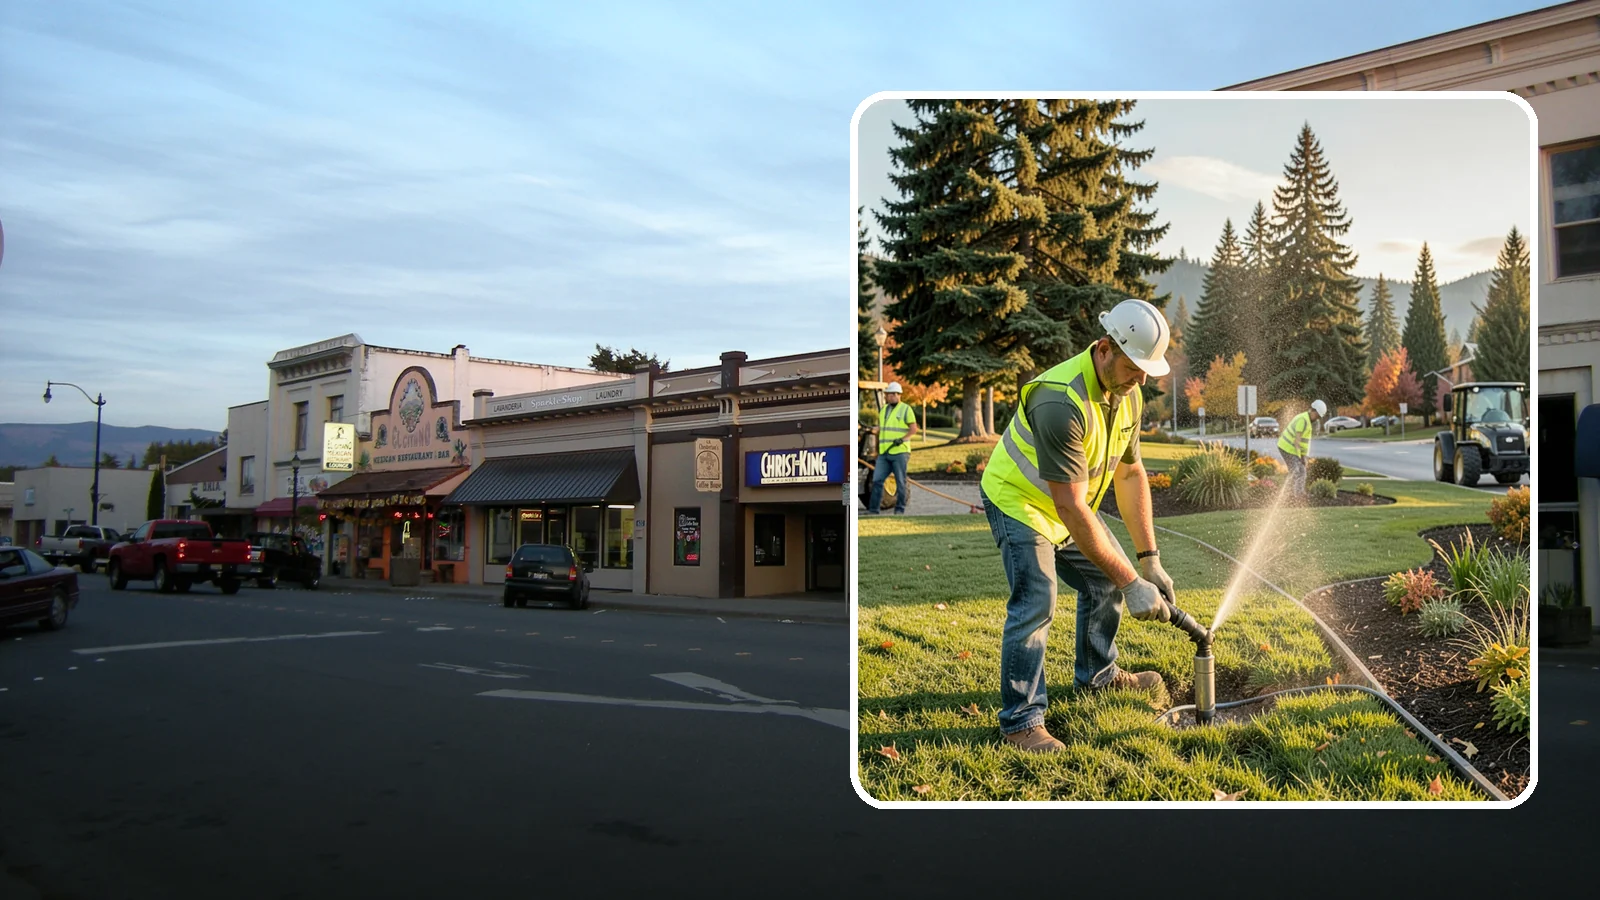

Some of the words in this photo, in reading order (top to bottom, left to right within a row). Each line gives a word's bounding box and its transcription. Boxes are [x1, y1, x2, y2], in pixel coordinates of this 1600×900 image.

[596, 389, 623, 400] LAUNDRY
[494, 402, 523, 412] LAVANDERIA
[531, 396, 561, 409] Sparkle
[562, 394, 582, 405] Shop
[374, 455, 396, 463] MEXICAN
[397, 451, 433, 462] RESTAURANT
[438, 450, 450, 459] BAR
[761, 452, 797, 478] CHRIST
[799, 450, 828, 476] KING
